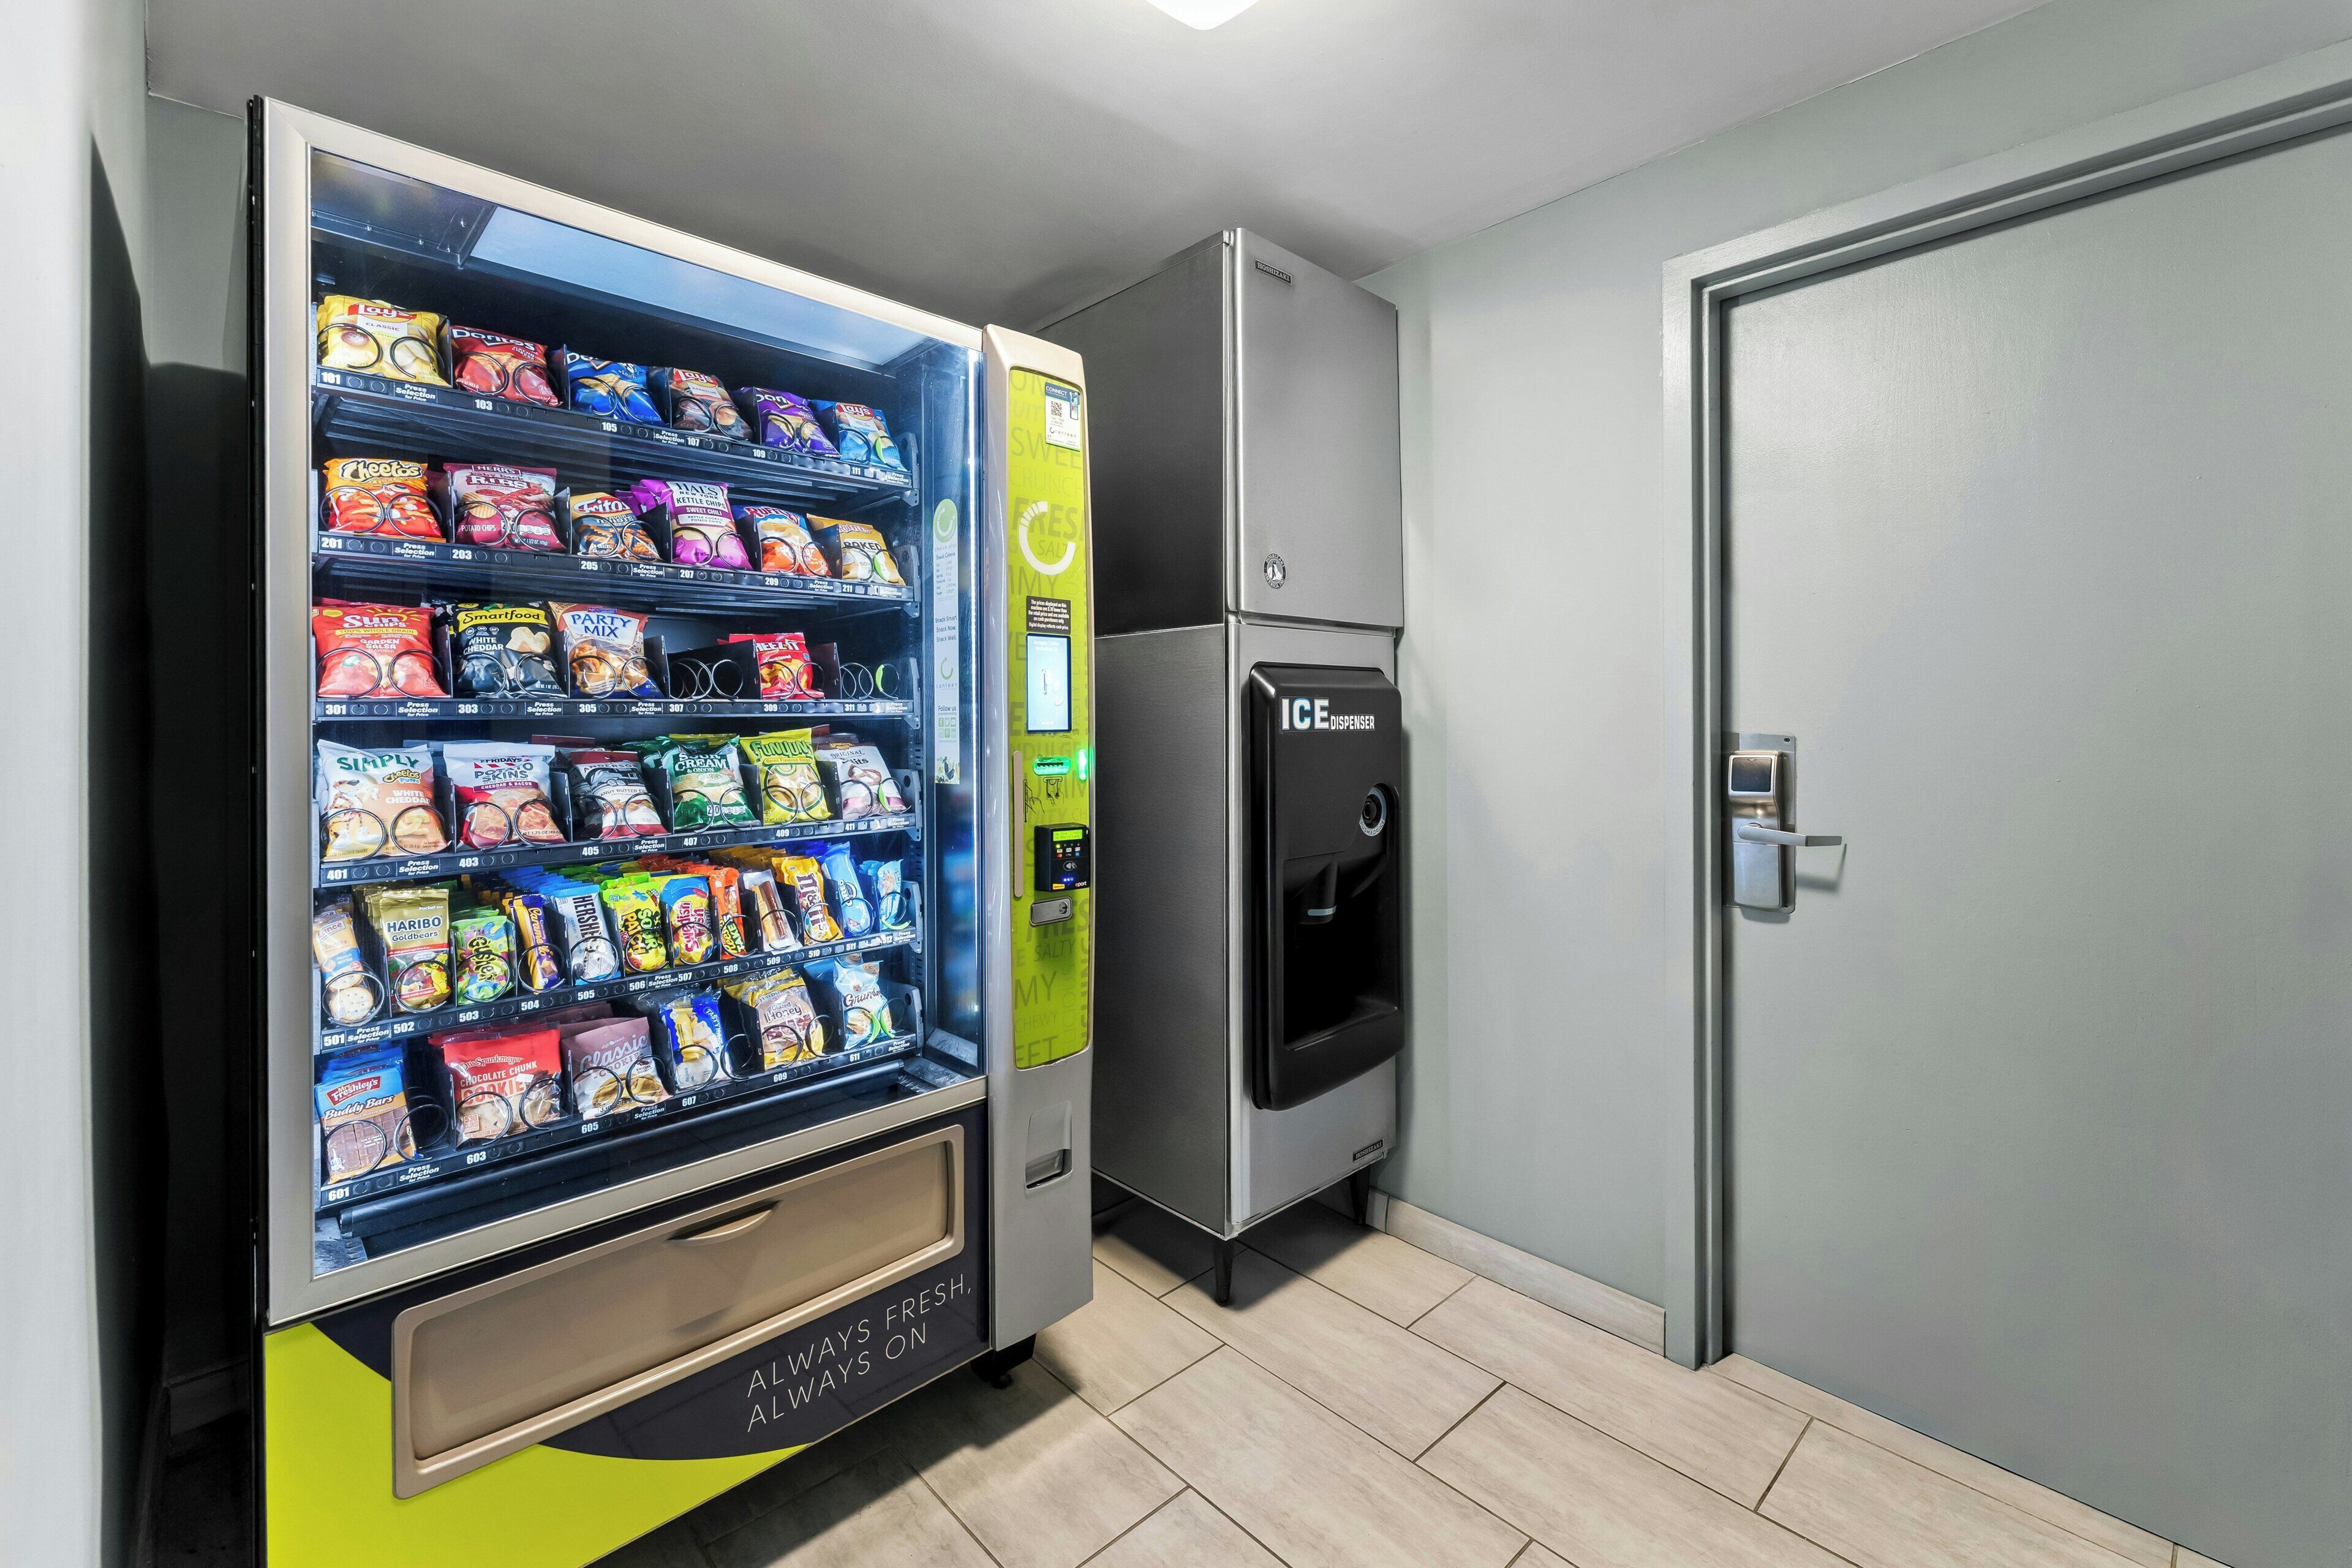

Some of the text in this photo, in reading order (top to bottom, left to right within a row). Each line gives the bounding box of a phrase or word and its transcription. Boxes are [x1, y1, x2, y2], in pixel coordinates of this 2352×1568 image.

[1257, 262, 1289, 281] HOSHIZAKI
[366, 322, 400, 331] CLASSIC
[451, 329, 536, 351] Doritos
[321, 372, 341, 384] 101
[680, 369, 712, 383] Lay's
[396, 387, 435, 399] Selection
[1046, 385, 1068, 396] CONNECT
[475, 399, 492, 410] 103
[842, 404, 872, 415] Lay's
[602, 422, 617, 432] 105
[687, 437, 699, 447] 107
[753, 448, 766, 458] 109
[342, 461, 422, 483] Cheetos
[477, 465, 516, 474] HERR'S
[470, 475, 529, 489] RIBS
[676, 483, 718, 496] HAL'S
[676, 497, 726, 510] KETTLE CHIPS
[321, 537, 342, 549] 201
[843, 541, 881, 551] BAKED
[394, 547, 435, 556] Selection
[452, 549, 472, 560] 203
[581, 560, 598, 570] 205
[680, 570, 694, 578] 207
[343, 615, 399, 628] Sun
[463, 610, 540, 624] Smartfood
[571, 614, 632, 628] PARTY
[584, 626, 619, 638] MIX
[469, 637, 497, 646] WHITE
[756, 641, 800, 652] HEEZ-IT
[464, 644, 503, 654] CHEDDAR
[325, 705, 347, 715] 301
[459, 704, 478, 714] 303
[579, 704, 597, 712] 305
[669, 704, 684, 712] 307
[1281, 698, 1375, 730] ICE DISPENSER
[750, 741, 813, 759] FUNYUNS
[830, 750, 865, 758] ORIGINAL
[337, 754, 420, 772] SIMPLY
[675, 759, 727, 772] CREAM
[383, 769, 420, 783] Cheetos
[475, 763, 533, 779] POTATO
[482, 771, 529, 782] SKINS
[684, 837, 698, 846] 407
[582, 846, 599, 856] 405
[459, 858, 479, 867] 403
[327, 869, 347, 880] 401
[387, 917, 442, 932] HARIBO
[392, 930, 439, 941] Goldbears
[846, 942, 856, 951] 511
[809, 949, 820, 958] 510
[767, 956, 781, 965] 509
[724, 964, 738, 973] 508
[679, 972, 692, 981] 507
[630, 981, 646, 991] 506
[578, 990, 595, 1000] 505
[521, 1000, 540, 1011] 504
[772, 1001, 791, 1011] Glazed
[459, 1011, 479, 1022] 503
[764, 1005, 802, 1023] Honey
[356, 1026, 380, 1035] Press
[393, 1022, 415, 1033] 502
[323, 1033, 345, 1046] 501
[347, 1029, 390, 1042] Selection
[579, 1034, 648, 1077] Classic
[460, 1054, 523, 1071] Otis Spunkmeyer
[460, 1061, 537, 1087] CHOCOLATE CHUNK
[774, 1072, 787, 1082] 609
[331, 1079, 379, 1102] Freshley's
[463, 1078, 524, 1105] COOKIE
[682, 1096, 697, 1106] 607
[324, 1095, 394, 1120] Buddy Bars
[582, 1121, 598, 1134] 605
[1355, 1142, 1382, 1159] HOSHIZAKI
[467, 1152, 486, 1164] 603
[399, 1166, 439, 1182] Selection
[409, 1164, 431, 1174] Press
[328, 1188, 349, 1201] 601
[747, 1273, 971, 1398] ALWAYS FRESH,
[747, 1322, 925, 1433] ALWAYS ON
